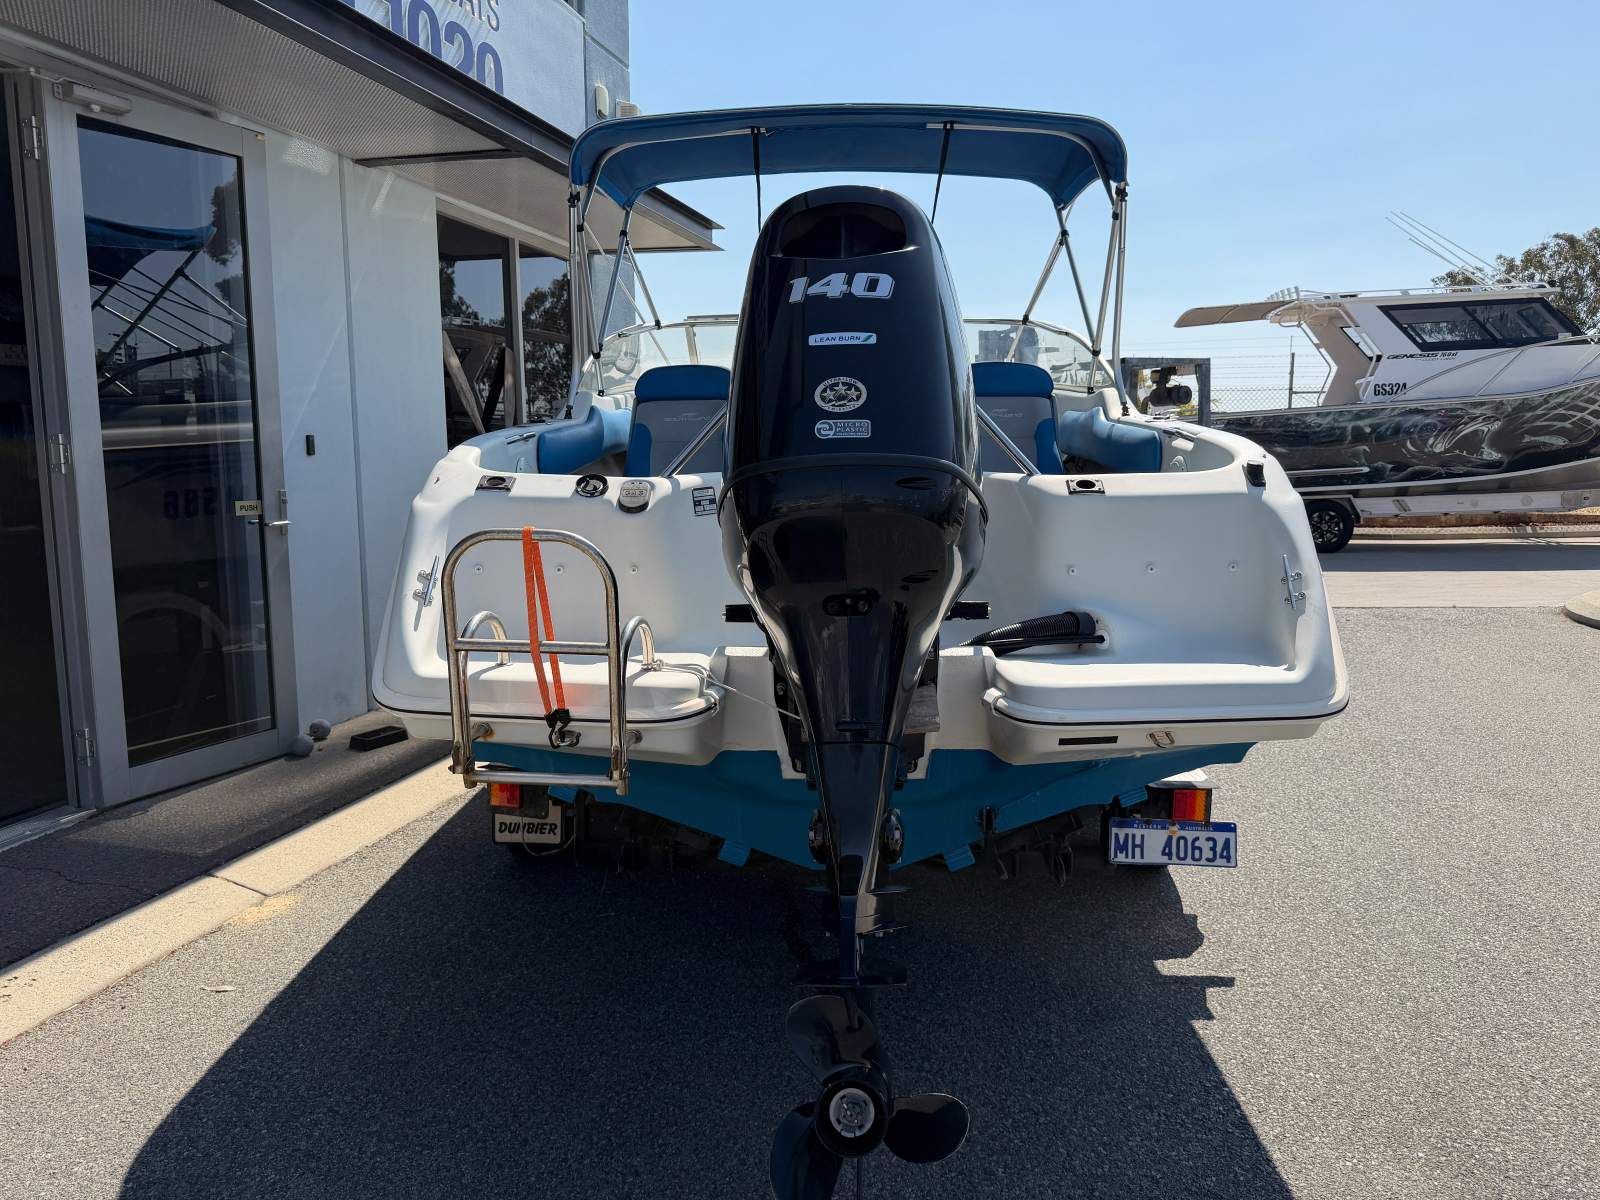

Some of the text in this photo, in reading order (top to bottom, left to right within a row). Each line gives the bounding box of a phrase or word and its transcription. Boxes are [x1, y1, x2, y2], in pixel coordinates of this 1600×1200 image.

[788, 272, 896, 304] 140
[1387, 352, 1439, 360] GENESIS
[239, 504, 258, 512] PUSH
[498, 822, 558, 835] DUNBIER
[1113, 832, 1232, 863] MH 40634
